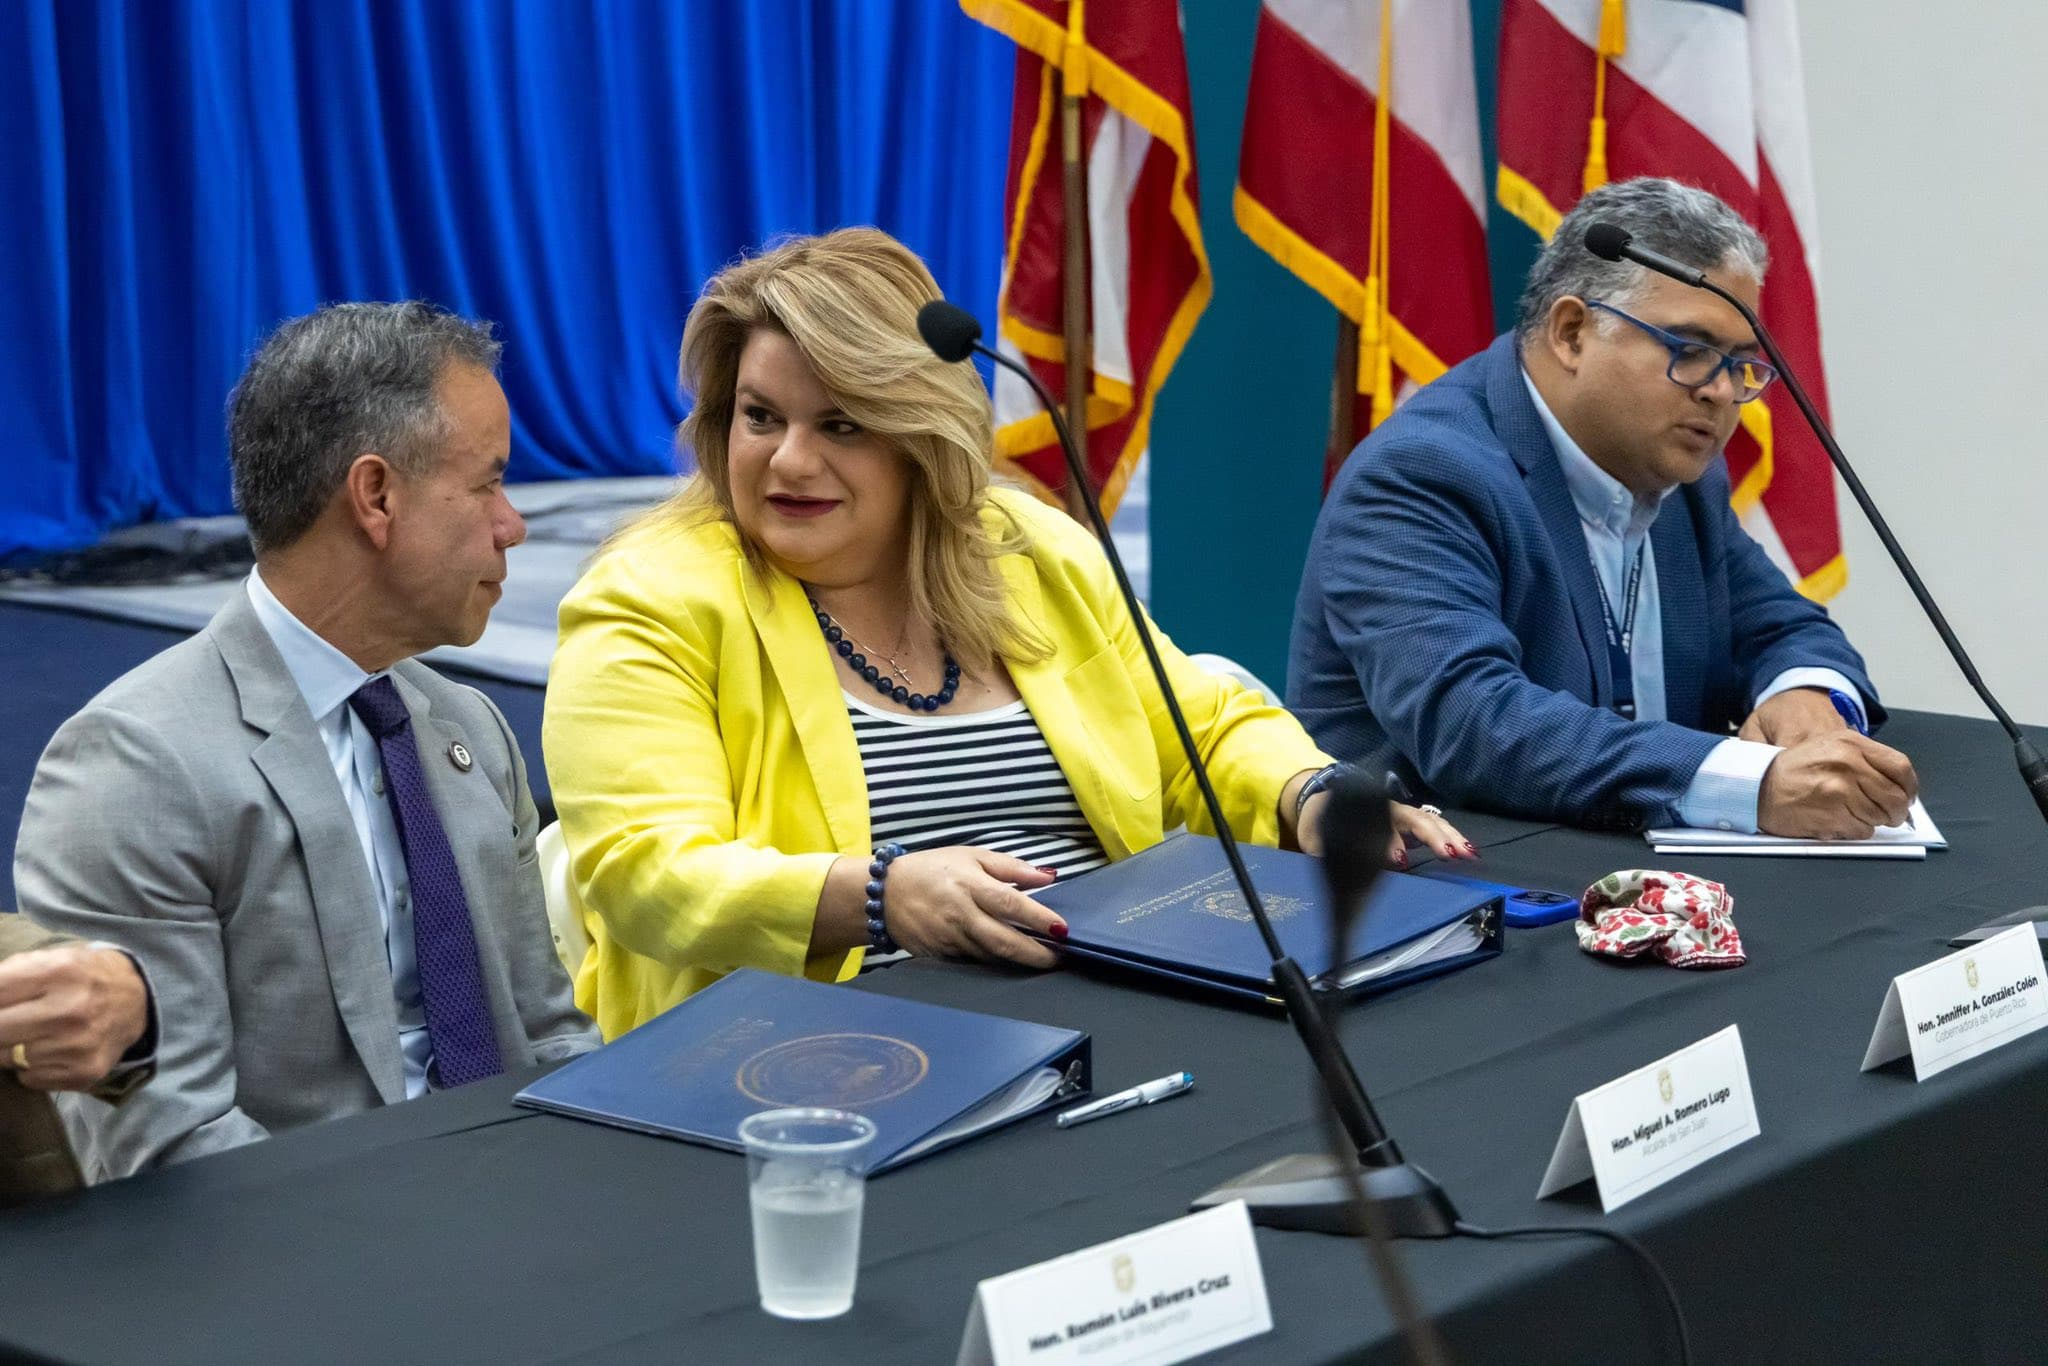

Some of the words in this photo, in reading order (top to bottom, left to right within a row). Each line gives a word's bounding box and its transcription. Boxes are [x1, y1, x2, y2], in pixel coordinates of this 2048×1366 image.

[1918, 1019, 1936, 1035] Hon.
[1936, 1004, 1970, 1027] Jenniffer
[1972, 1000, 1981, 1012] A.
[1981, 985, 2015, 1007] González
[2016, 975, 2039, 992] Colón
[1980, 1012, 1989, 1025] de
[1990, 1003, 2012, 1020] Puerto
[2013, 997, 2027, 1010] Rico
[1611, 1136, 1633, 1153] Hon.
[1633, 1116, 1663, 1141] Miguel
[1665, 1113, 1674, 1127] A.
[1674, 1098, 1708, 1122] Romero
[1708, 1087, 1730, 1105] Lugo
[1028, 1332, 1062, 1353] Hon.
[1066, 1312, 1116, 1340] Ramón
[1118, 1298, 1148, 1322] Luis
[1150, 1285, 1196, 1311] Rivera
[1198, 1273, 1231, 1295] Cruz
